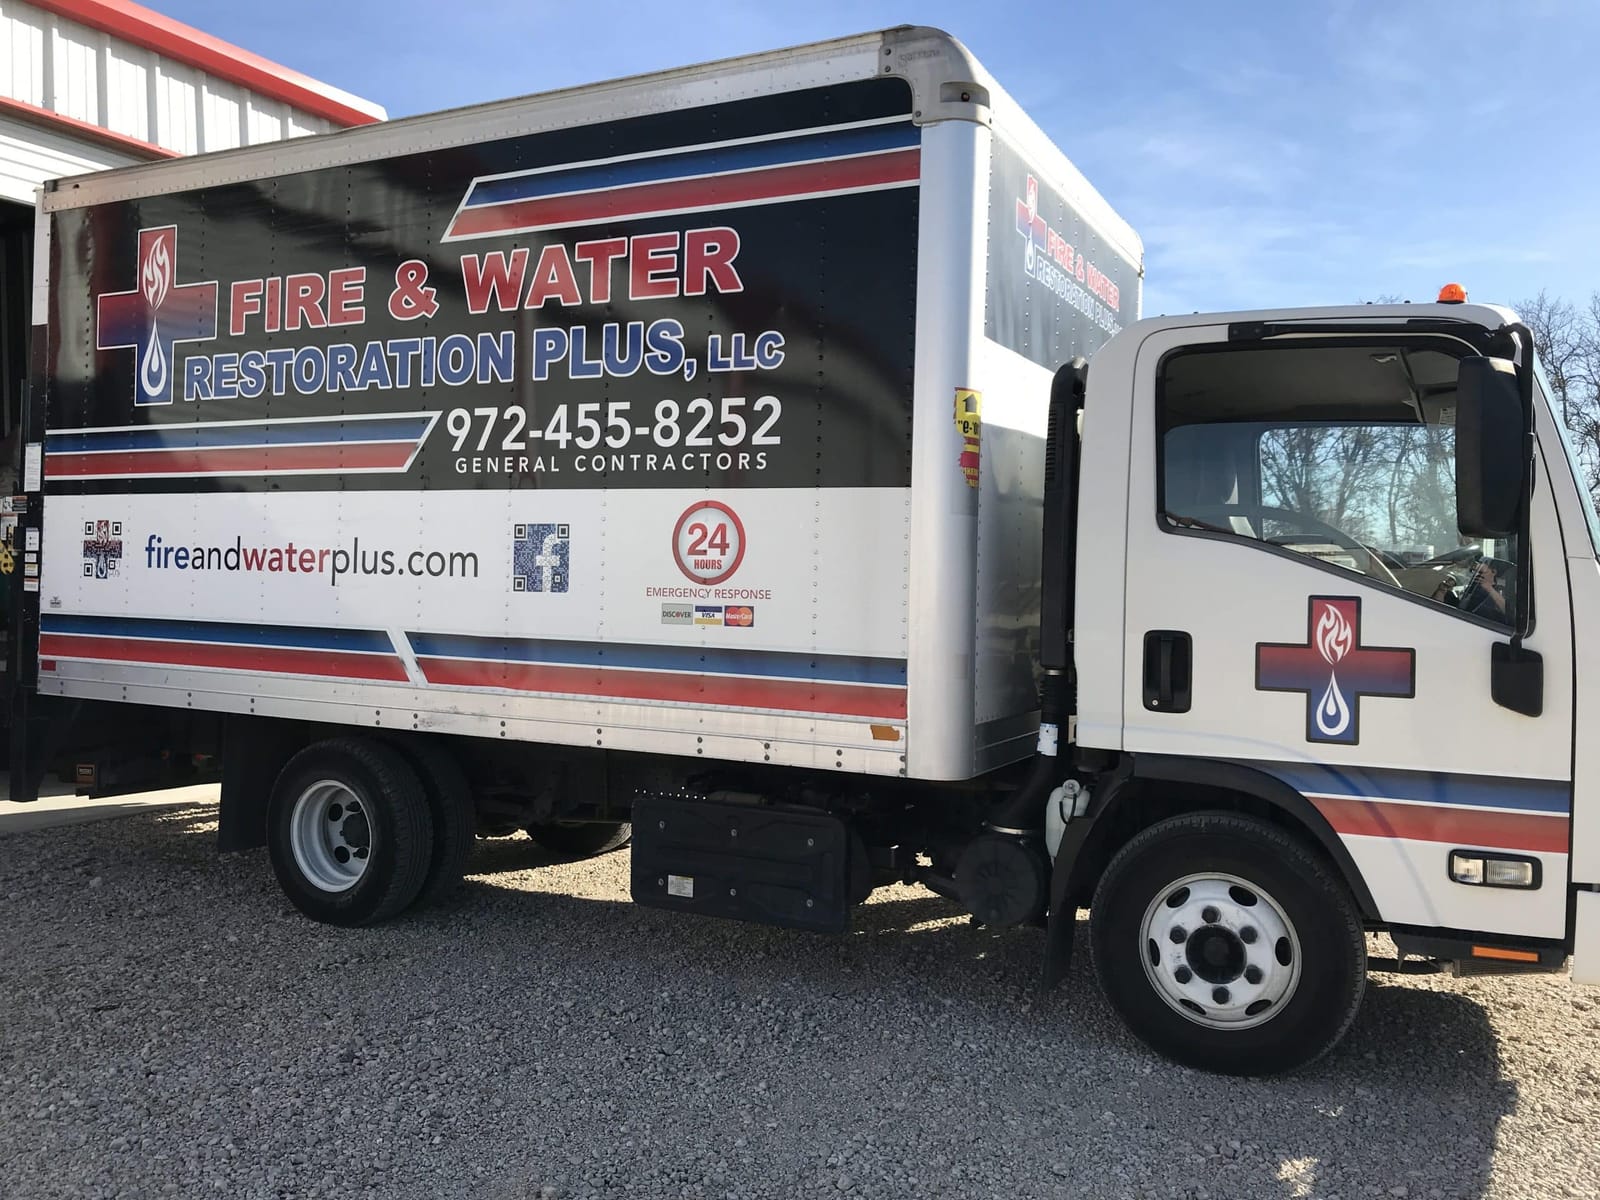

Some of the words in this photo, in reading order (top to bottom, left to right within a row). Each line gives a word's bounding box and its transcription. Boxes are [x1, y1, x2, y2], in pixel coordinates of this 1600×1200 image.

[230, 266, 366, 336] FIRE
[388, 260, 439, 320] &
[460, 226, 744, 314] WATER
[1047, 227, 1074, 274] FIRE
[1087, 261, 1120, 312] WATER
[184, 332, 515, 401] RESTORATION
[532, 319, 697, 381] PLUS,
[708, 331, 785, 372] LLC
[447, 396, 782, 451] 972-455-8252
[455, 456, 560, 474] GENERAL
[574, 452, 767, 472] CONTRACTORS
[687, 522, 730, 556] 24
[145, 535, 479, 586] fireandwaterplus.com
[694, 559, 722, 570] HOURS
[646, 587, 712, 598] EMERGENCY
[714, 589, 772, 600] RESPONSE
[662, 611, 692, 619] DISCOVER
